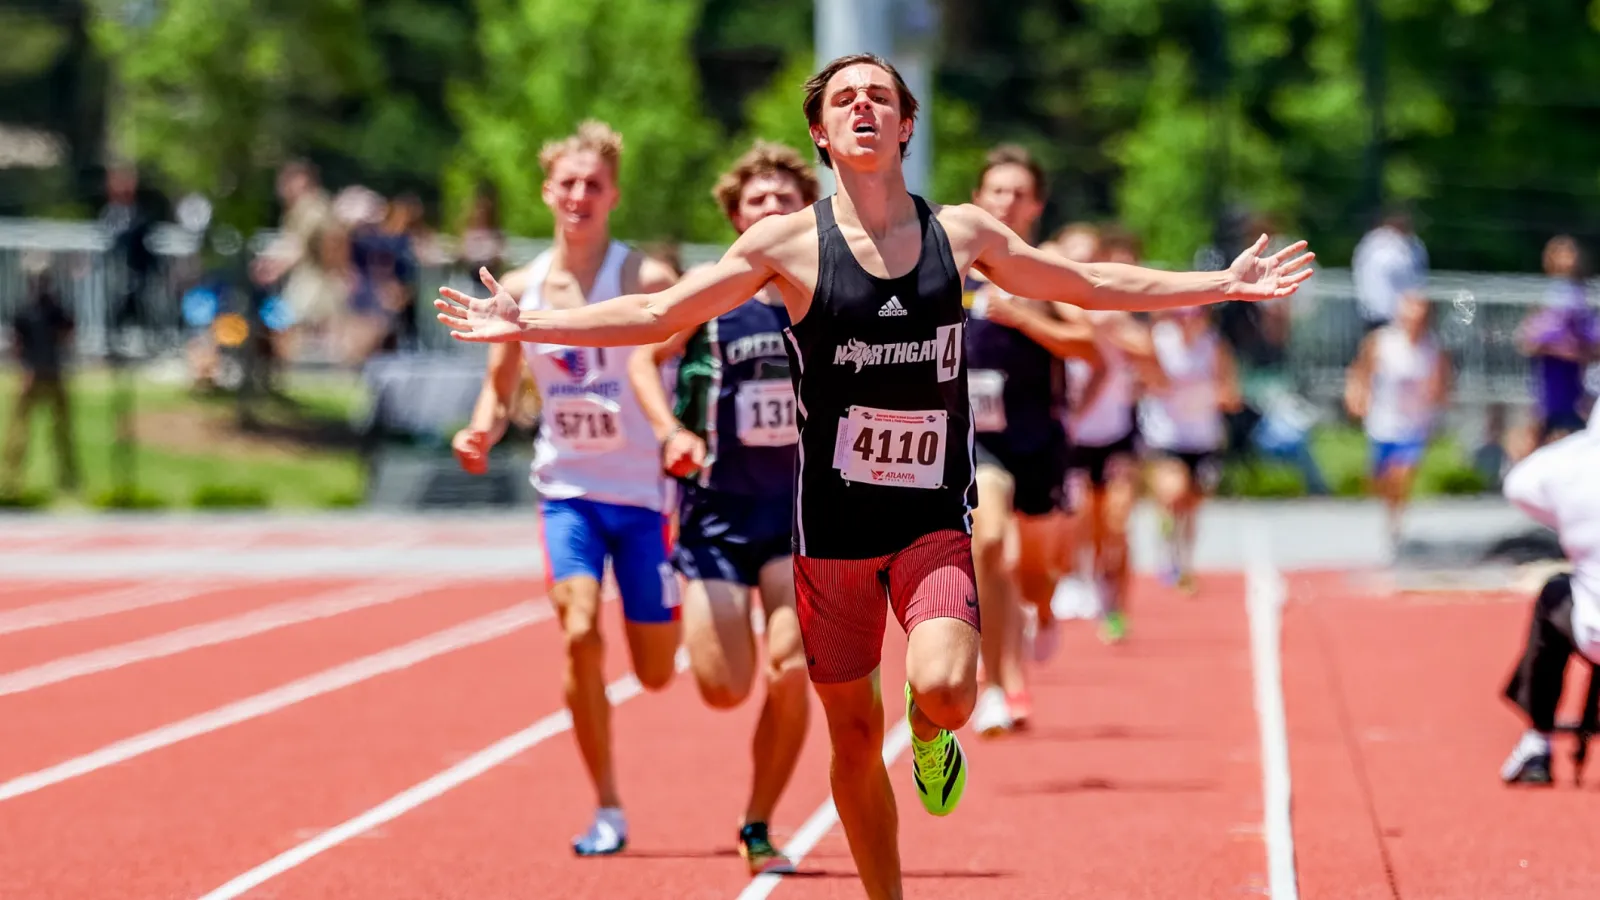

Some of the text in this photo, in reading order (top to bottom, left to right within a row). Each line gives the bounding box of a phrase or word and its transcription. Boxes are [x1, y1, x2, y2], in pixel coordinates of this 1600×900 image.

[878, 308, 908, 317] adidas
[833, 338, 938, 369] NORTHGAT
[942, 328, 957, 377] 4
[555, 412, 617, 439] 5718
[751, 400, 797, 429] 131
[852, 427, 939, 466] 4110
[885, 471, 915, 480] ATLANTA
